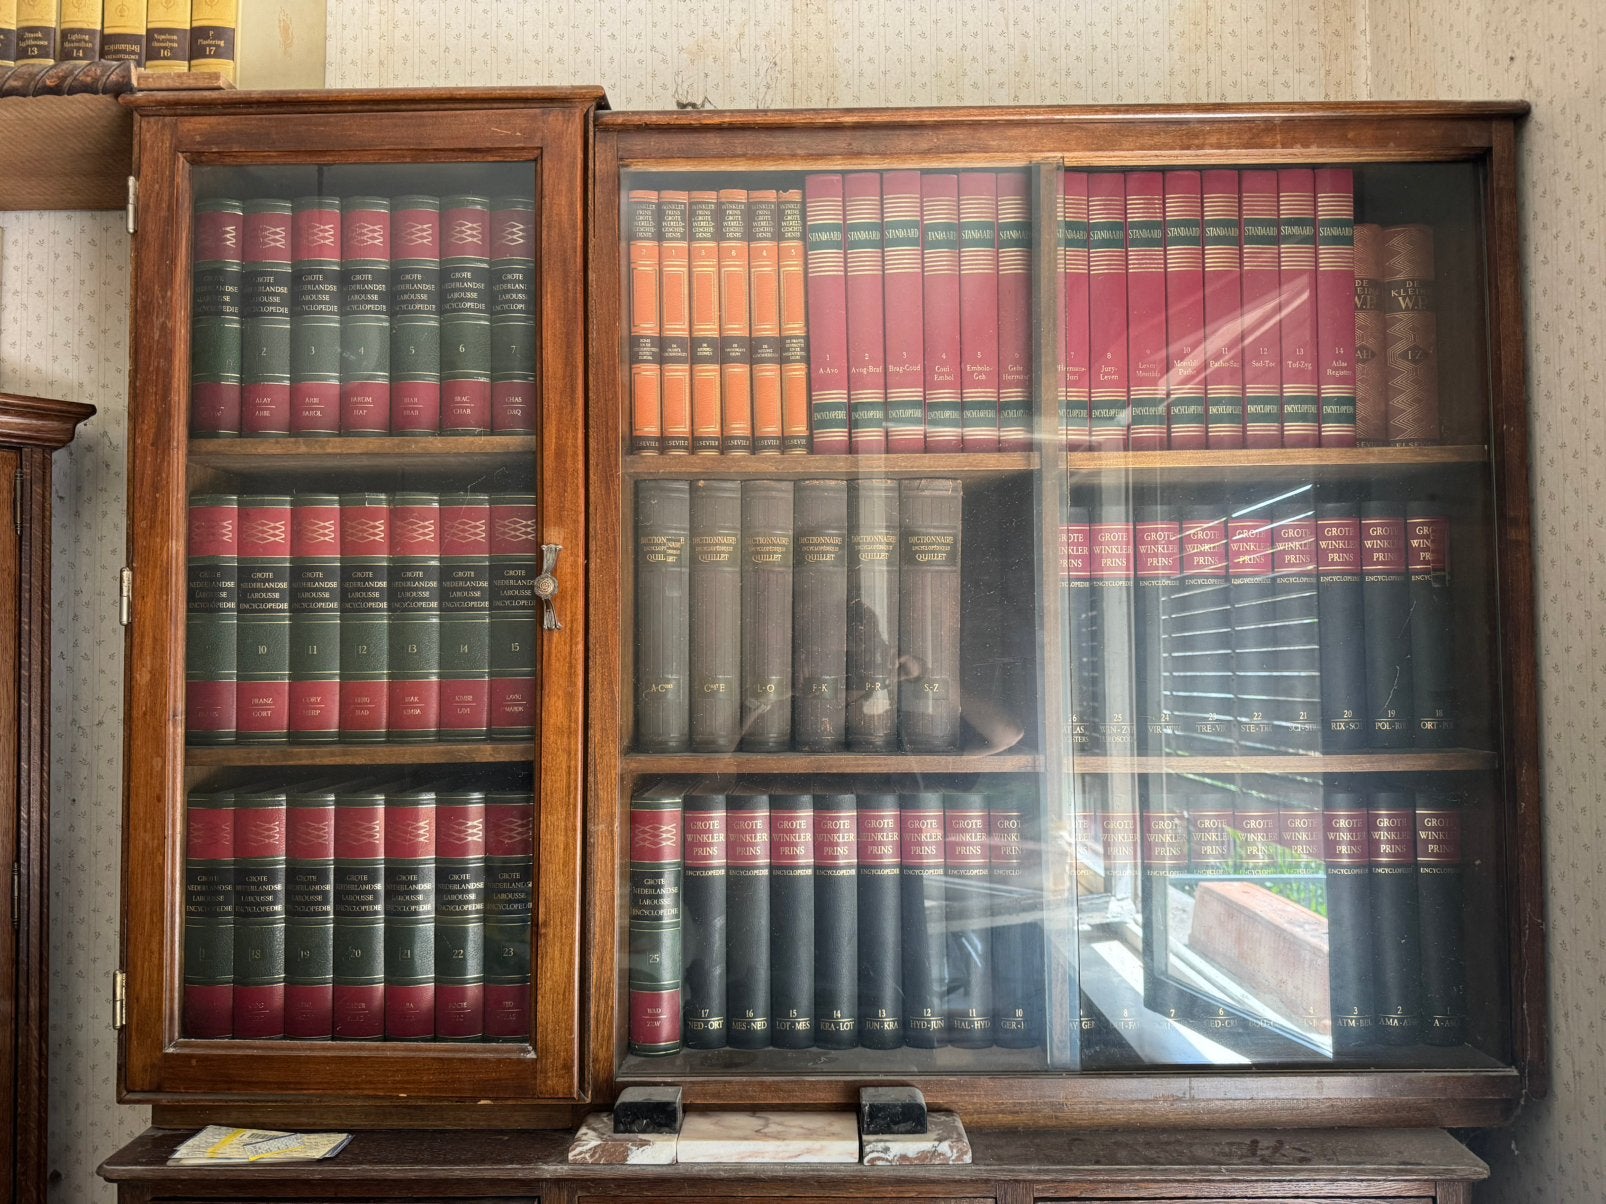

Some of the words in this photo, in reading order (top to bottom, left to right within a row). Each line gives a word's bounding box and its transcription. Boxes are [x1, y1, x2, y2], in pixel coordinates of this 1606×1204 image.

[72, 49, 83, 57] 14
[160, 49, 171, 57] 16
[206, 46, 215, 55] 17
[885, 228, 918, 239] STANDAARD
[1167, 226, 1200, 237] STANDAARD
[1205, 227, 1238, 237] STANDAARD
[1244, 226, 1277, 236] STANDAARD
[1281, 225, 1314, 235] STANDAARD
[1319, 226, 1353, 237] STANDAARD
[809, 230, 841, 242] STANDAARD
[848, 230, 880, 240] STANDAARD
[1090, 230, 1124, 240] STANDAARD
[261, 347, 267, 356] 2
[309, 346, 316, 356] 3
[410, 346, 415, 354] 5
[459, 344, 465, 353] 6
[510, 345, 520, 354] 7
[1327, 369, 1352, 377] Register
[1144, 532, 1174, 541] GROTE
[1324, 527, 1355, 537] GROTE
[1098, 532, 1128, 542] GROTE
[1093, 546, 1132, 554] WINKLER
[698, 554, 730, 563] QUILLET
[752, 554, 782, 563] QUILLET
[805, 553, 835, 562] QUILLET
[859, 553, 889, 561] QUILLET
[915, 553, 947, 562] QUILLET
[1285, 554, 1311, 563] PRINS
[1328, 552, 1354, 561] PRINS
[1102, 559, 1126, 567] PRINS
[1148, 557, 1173, 566] PRINS
[258, 645, 267, 655] 10
[308, 645, 317, 654] 11
[408, 644, 417, 653] 13
[460, 644, 468, 653] 14
[512, 643, 520, 652] 15
[924, 683, 939, 692] S-Z
[1113, 713, 1122, 721] 25
[1161, 713, 1169, 721] 24
[1253, 712, 1262, 720] 22
[1299, 712, 1307, 720] 21
[1344, 710, 1352, 718] 20
[1436, 709, 1443, 717] 18
[691, 820, 720, 830] GROTE
[734, 820, 762, 830] GROTE
[777, 820, 806, 830] GROTE
[865, 819, 894, 828] GROTE
[907, 819, 938, 828] GROTE
[686, 833, 724, 842] WINKLER
[729, 833, 768, 842] WINKLER
[772, 833, 811, 842] WINKLER
[693, 847, 718, 856] PRINS
[736, 847, 761, 856] PRINS
[780, 847, 805, 856] PRINS
[868, 846, 892, 855] PRINS
[911, 846, 936, 855] PRINS
[1201, 846, 1227, 855] PRINS
[1336, 845, 1362, 854] PRINS
[1380, 844, 1406, 854] PRINS
[401, 949, 411, 959] 21
[453, 950, 463, 959] 22
[503, 947, 514, 957] 23
[648, 954, 660, 963] 25
[700, 1009, 708, 1017] 17
[746, 1009, 754, 1018] 16
[789, 1009, 797, 1017] 15
[879, 1009, 886, 1017] 13
[923, 1009, 931, 1017] 12
[969, 1009, 976, 1017] 11
[1015, 1009, 1023, 1017] 10
[1170, 1009, 1175, 1017] 7
[1353, 1006, 1358, 1014] 3
[1397, 1005, 1402, 1014] 2
